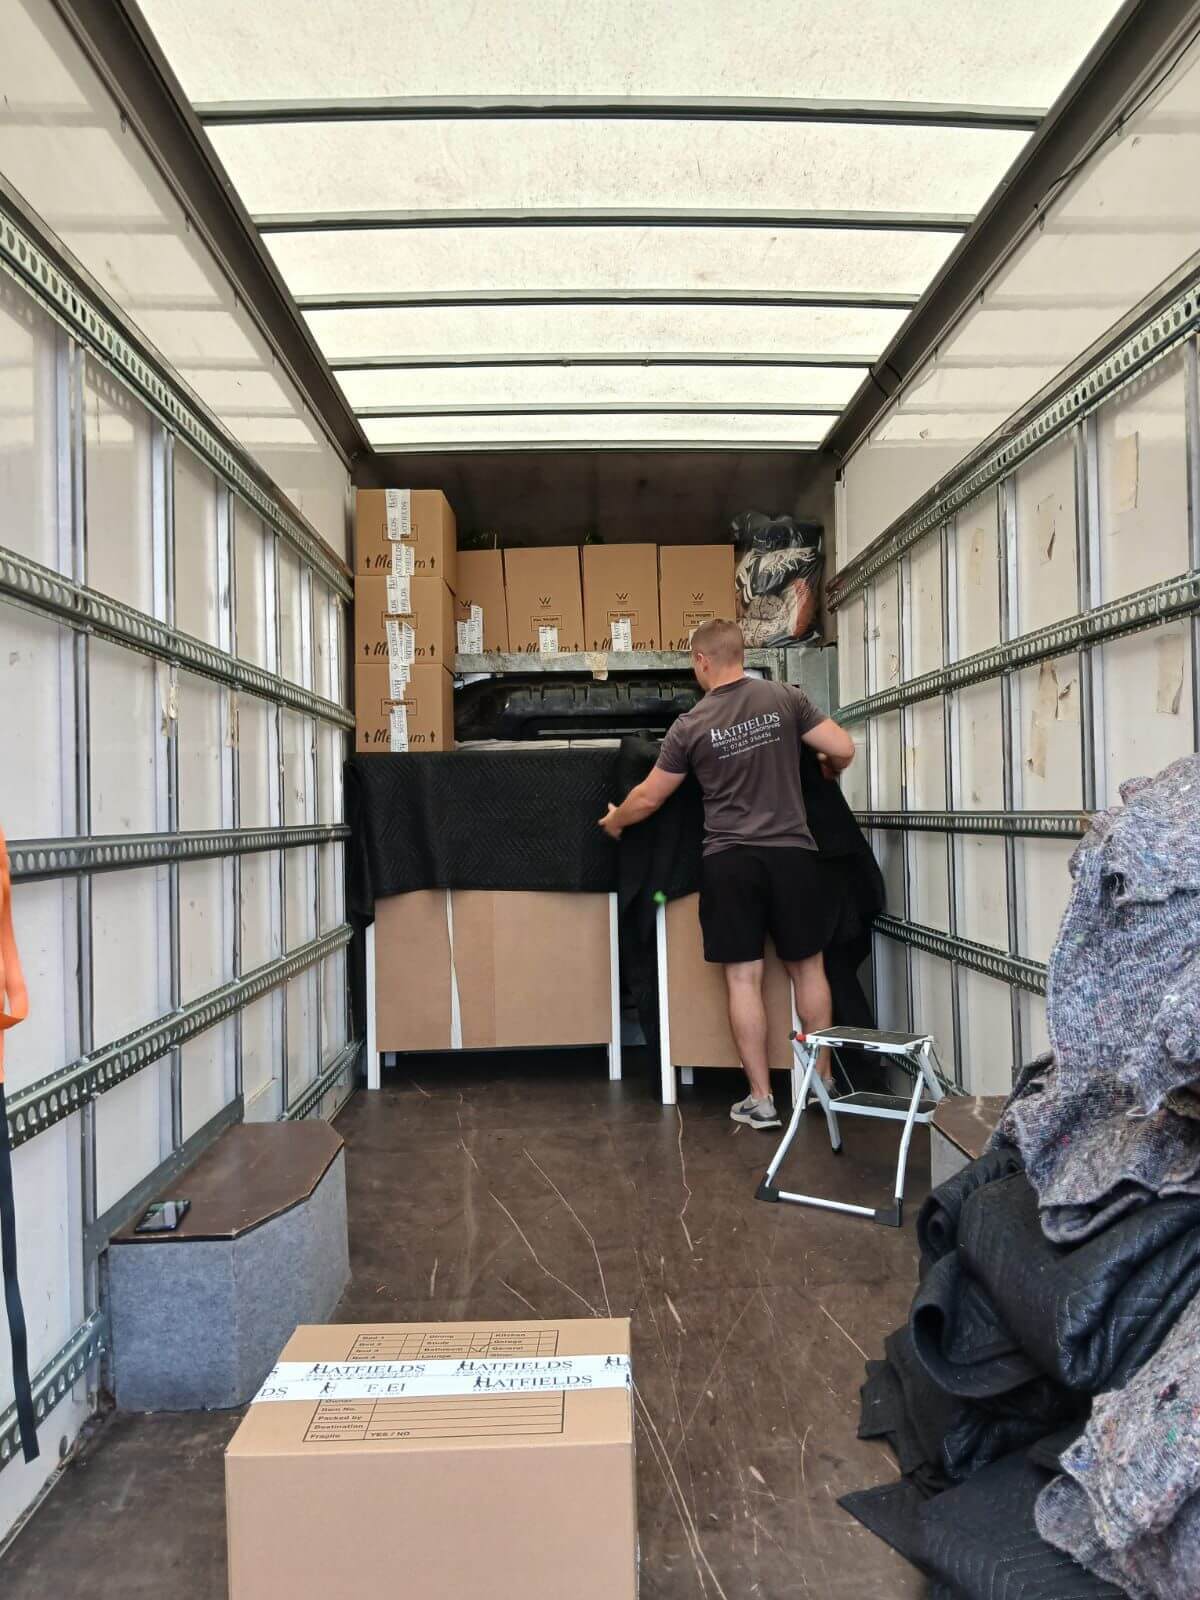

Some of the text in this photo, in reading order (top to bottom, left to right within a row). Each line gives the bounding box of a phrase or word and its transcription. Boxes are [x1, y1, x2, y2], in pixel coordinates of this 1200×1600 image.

[711, 711, 781, 743] HATFIELDS
[309, 1363, 426, 1375] HATFIELDS
[457, 1359, 573, 1371] HATFIELDS
[473, 1375, 592, 1388] HATFIELDS
